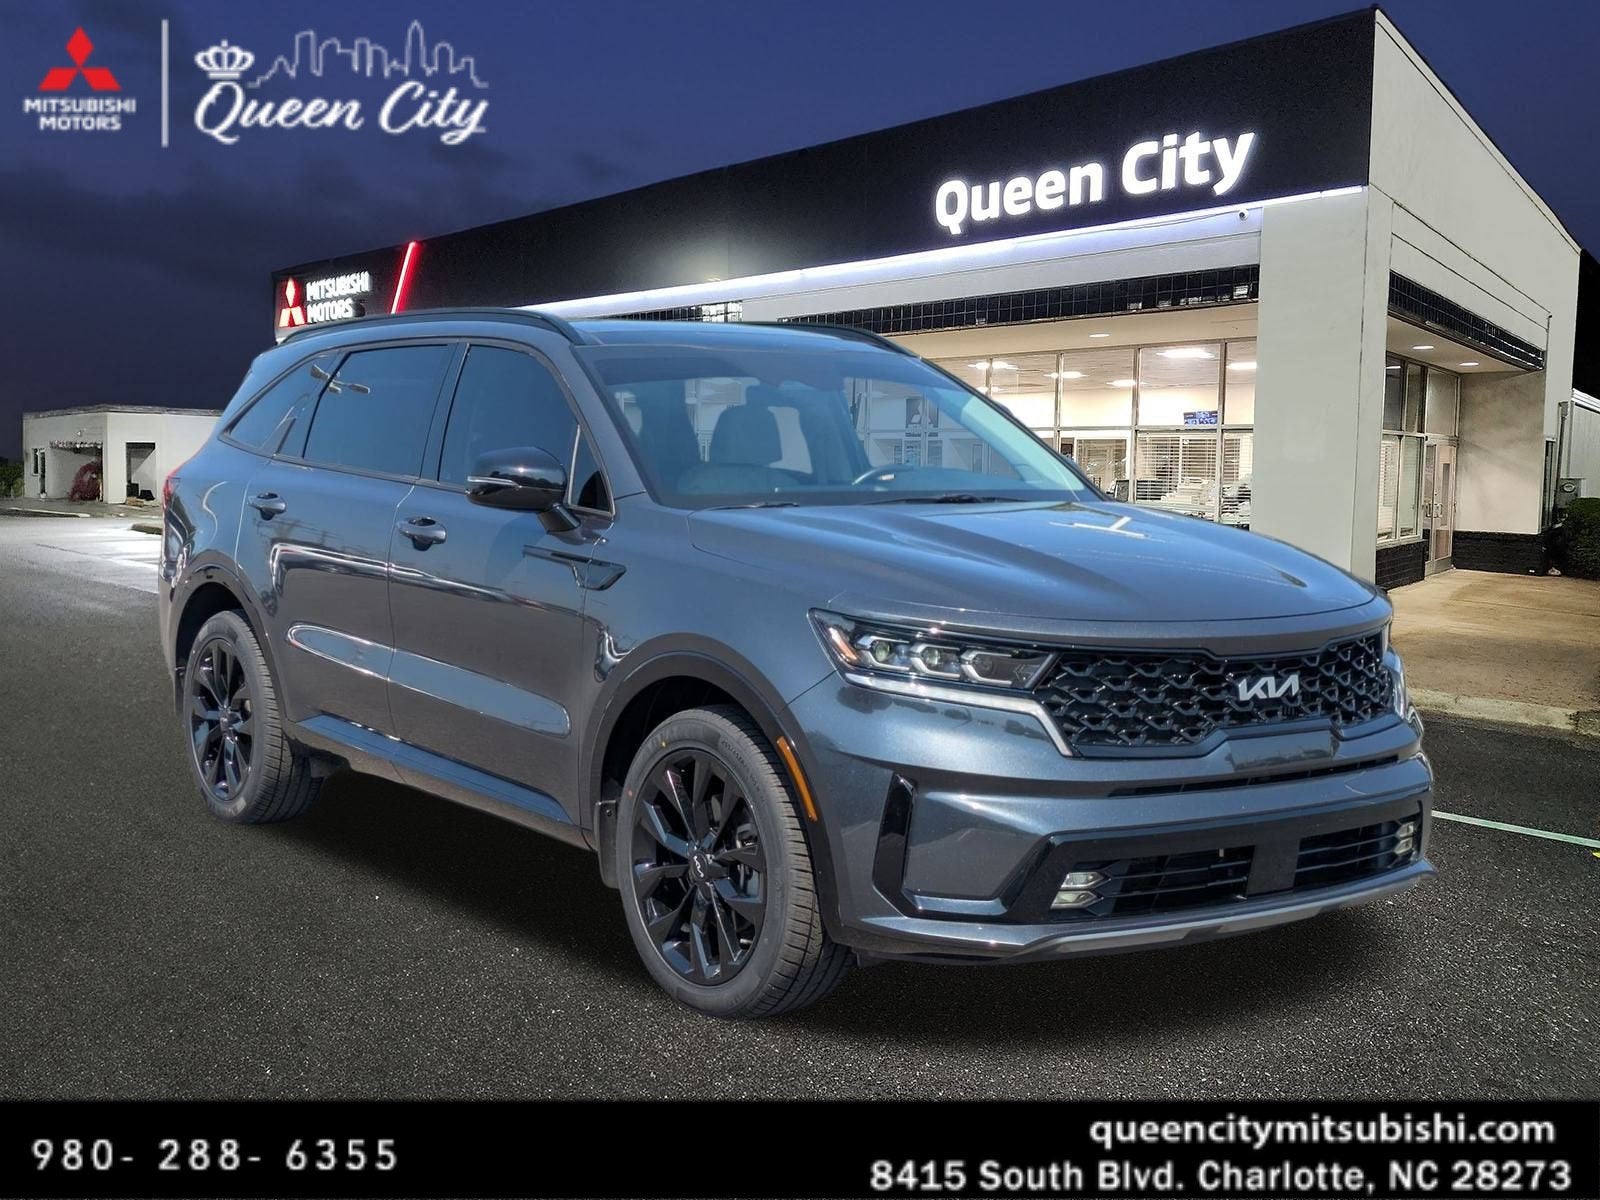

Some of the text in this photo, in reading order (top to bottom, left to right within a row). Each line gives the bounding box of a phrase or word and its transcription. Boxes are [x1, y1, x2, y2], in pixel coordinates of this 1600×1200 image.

[935, 131, 1256, 235] Queen City
[306, 271, 370, 301] MITSUBISHI
[307, 298, 354, 323] MOTORS
[1238, 674, 1300, 701] KIA
